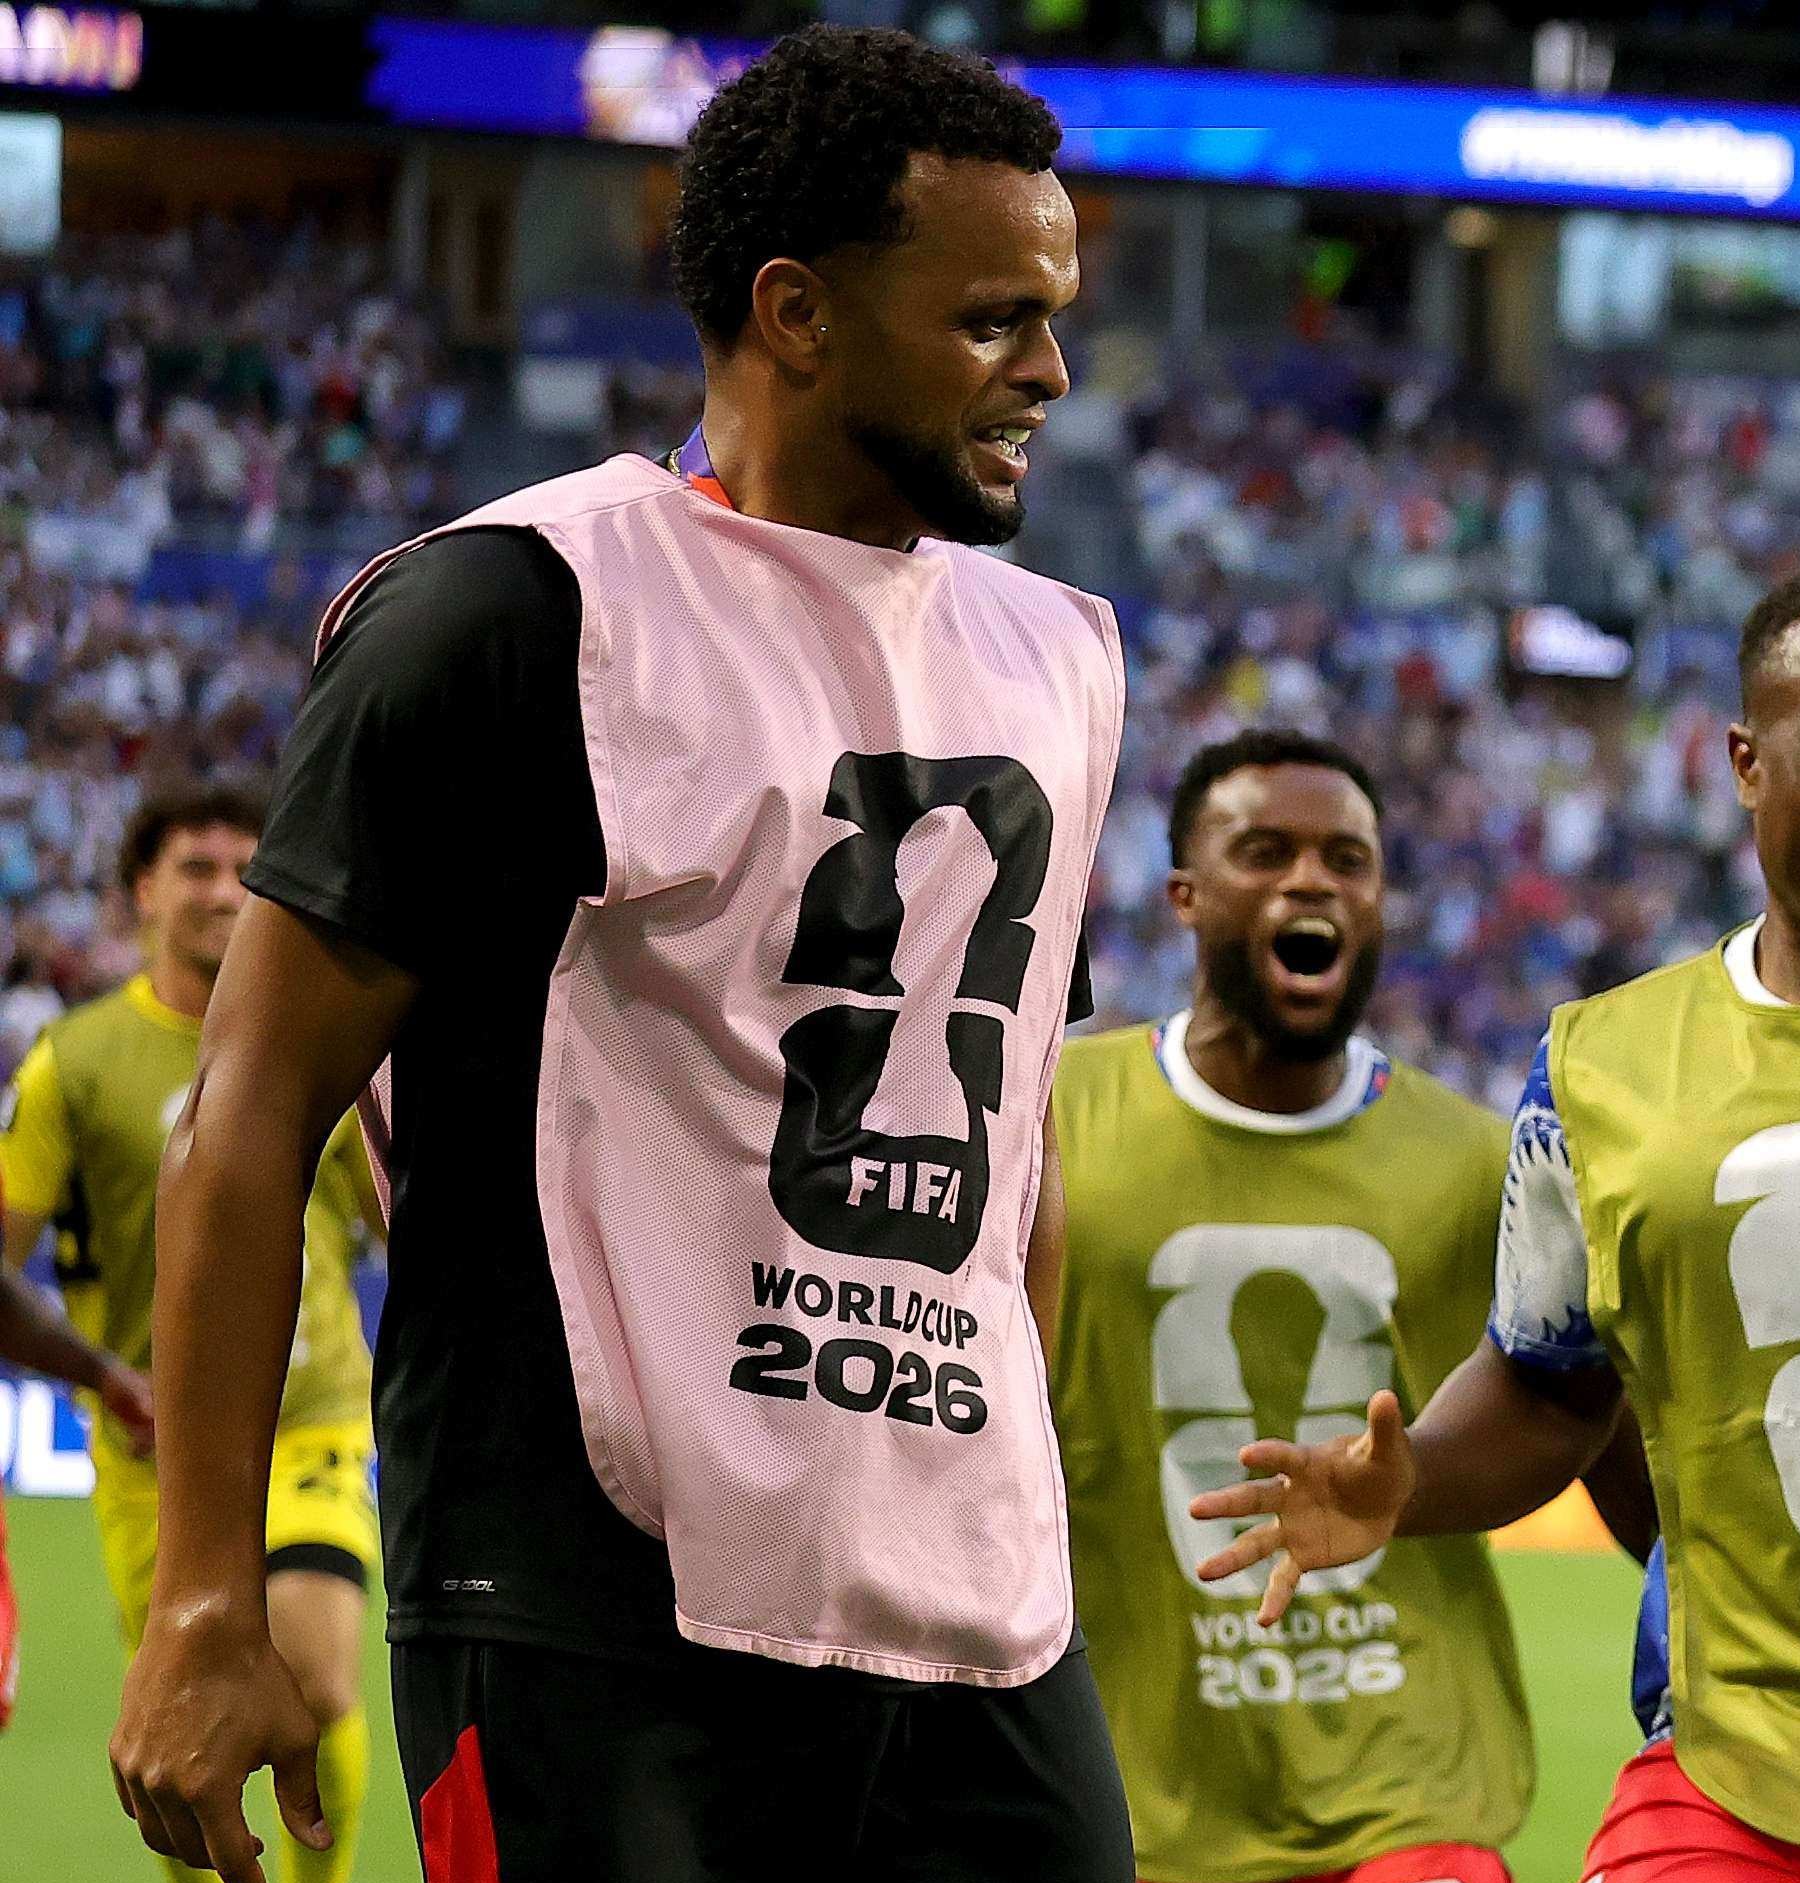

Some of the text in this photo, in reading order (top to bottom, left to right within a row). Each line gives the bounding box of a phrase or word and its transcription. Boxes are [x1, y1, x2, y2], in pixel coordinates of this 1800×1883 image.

[846, 1155, 962, 1224] FIFA
[751, 1261, 978, 1349] WORLD CUP
[729, 1323, 988, 1435] 2026
[1197, 1641, 1408, 1710] 2026
